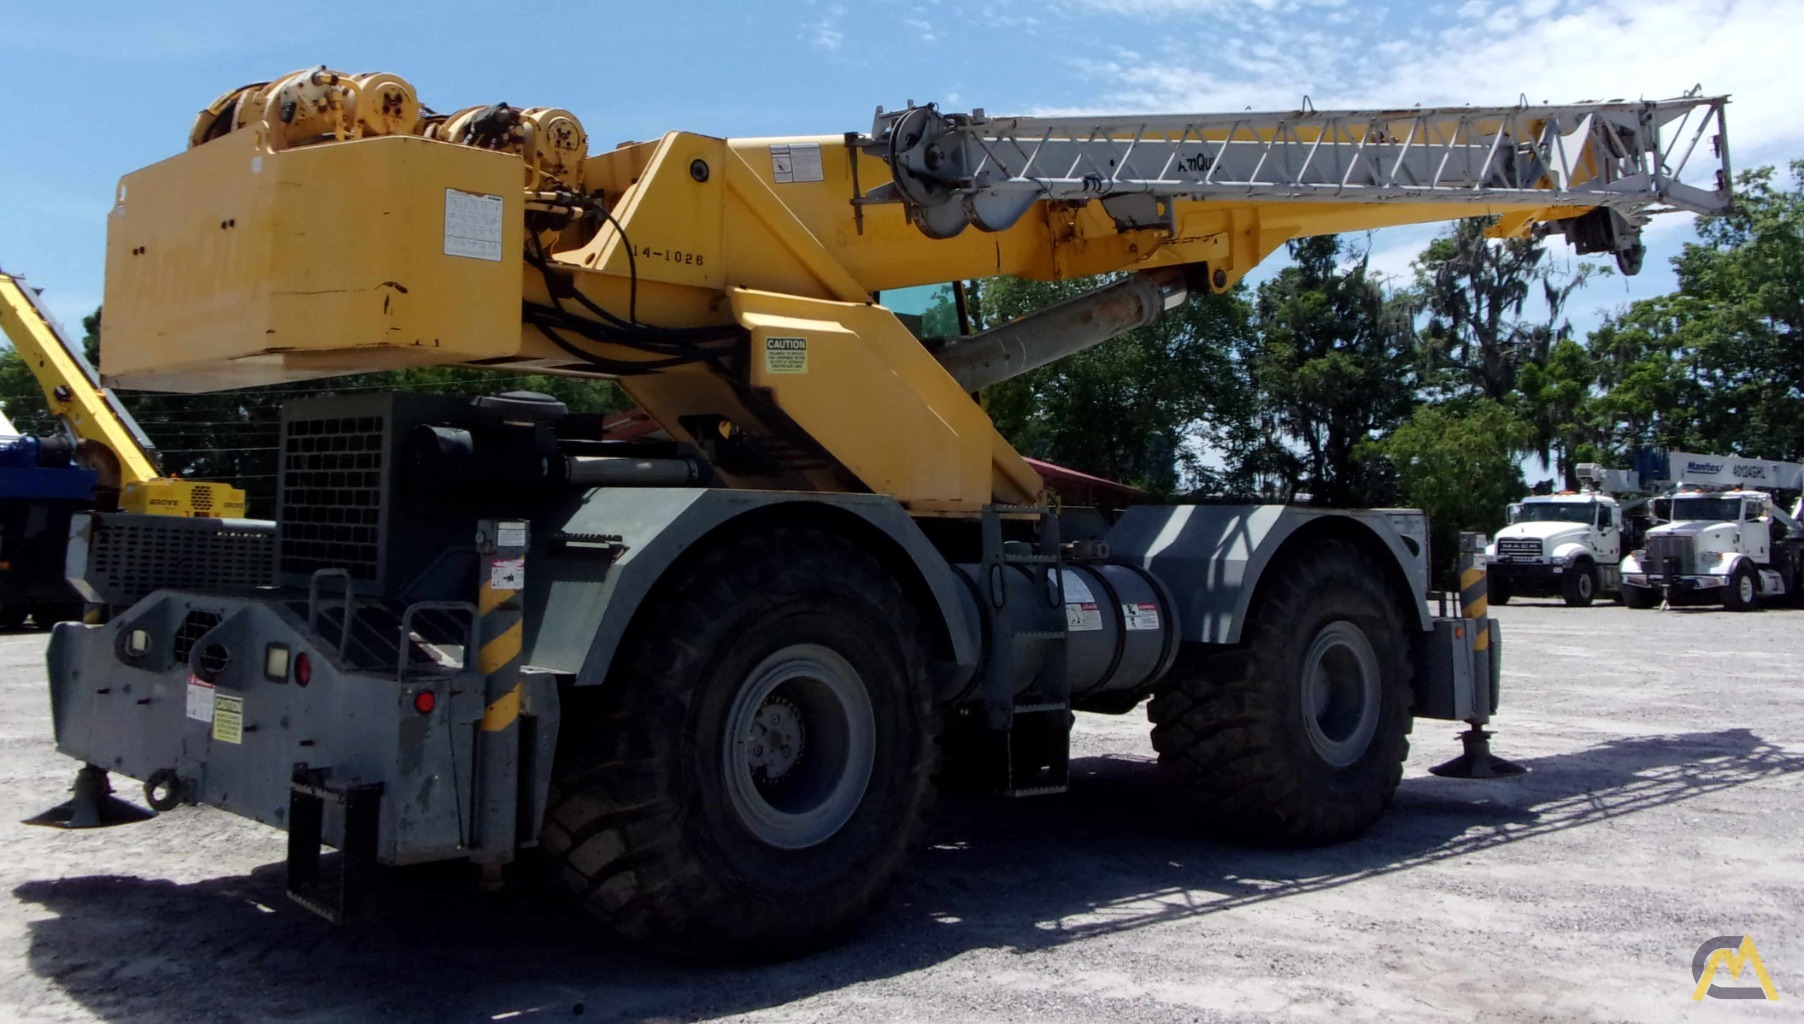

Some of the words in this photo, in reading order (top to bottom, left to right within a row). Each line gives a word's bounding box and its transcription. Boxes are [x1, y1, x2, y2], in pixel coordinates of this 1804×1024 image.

[633, 244, 704, 266] 14-1026
[767, 339, 806, 349] CAUTION
[1686, 461, 1721, 472] Manitex
[148, 499, 179, 507] GROVE
